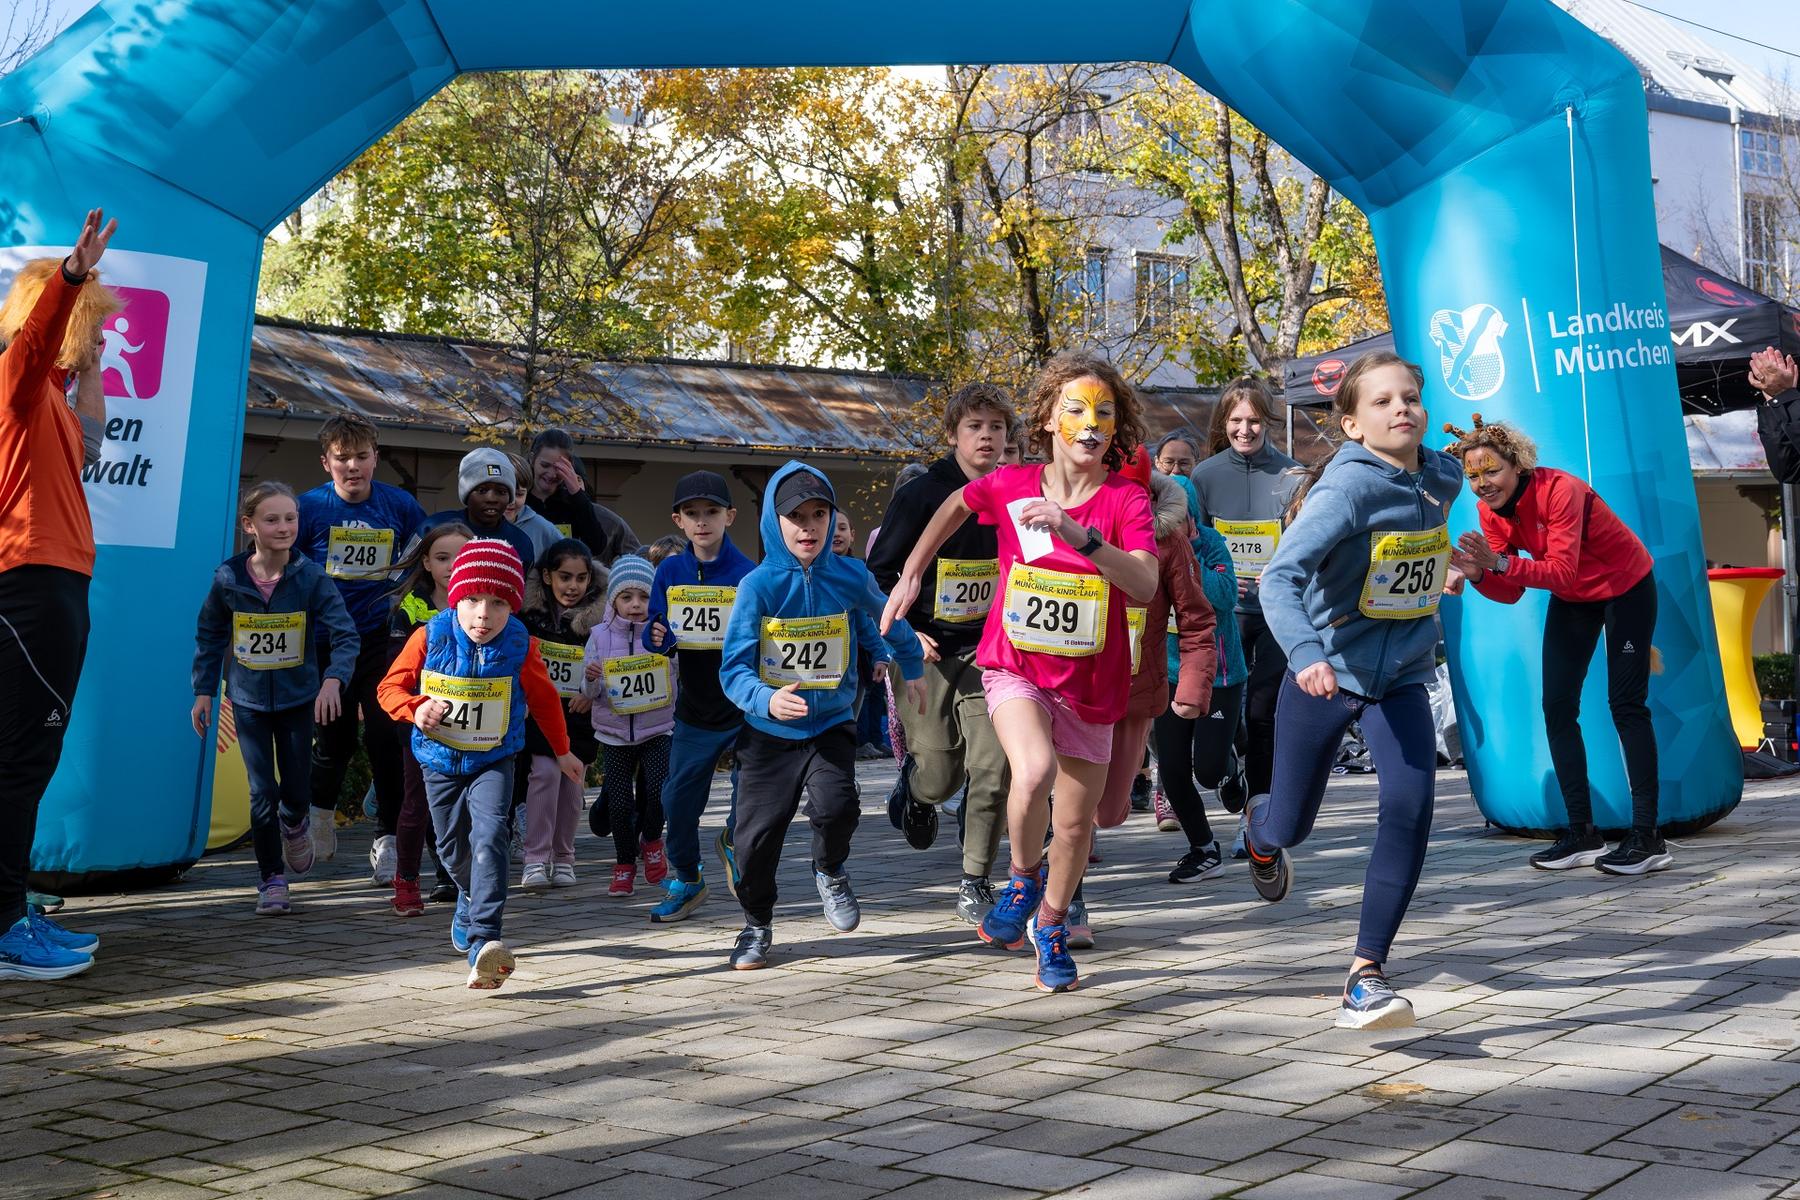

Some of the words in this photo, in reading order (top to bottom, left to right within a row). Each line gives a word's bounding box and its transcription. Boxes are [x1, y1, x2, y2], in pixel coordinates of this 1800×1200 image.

[1548, 302, 1665, 338] Landkreis
[1554, 338, 1671, 376] München
[105, 417, 143, 442] en
[82, 454, 153, 486] walt
[343, 545, 376, 566] 248
[1231, 542, 1262, 553] 2178
[1389, 557, 1435, 594] 258
[955, 581, 991, 603] 200
[682, 607, 720, 632] 245
[1025, 596, 1079, 634] 239
[250, 632, 287, 654] 234
[781, 641, 828, 670] 242
[620, 672, 655, 698] 240
[440, 700, 483, 730] 241
